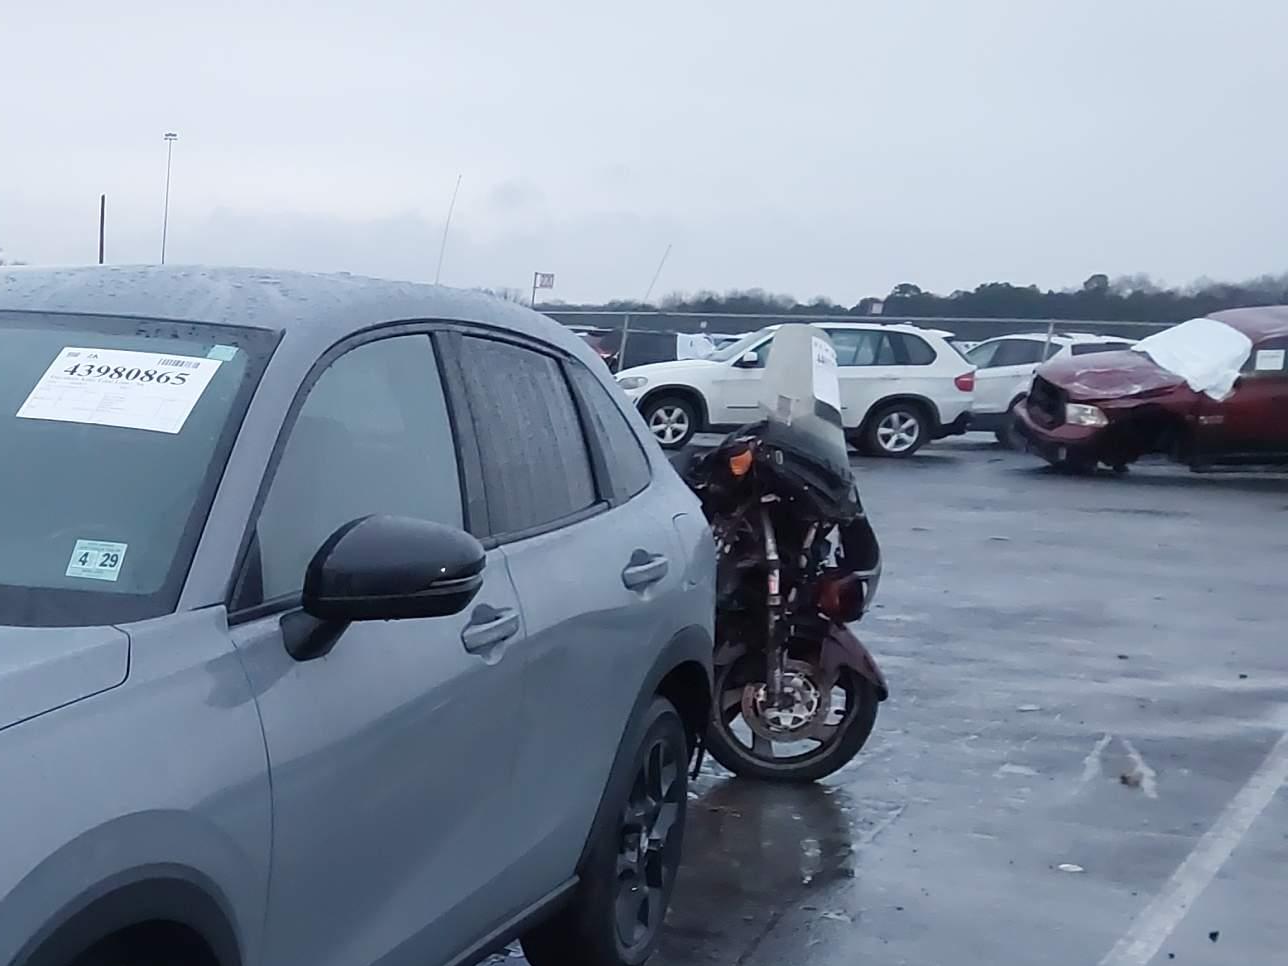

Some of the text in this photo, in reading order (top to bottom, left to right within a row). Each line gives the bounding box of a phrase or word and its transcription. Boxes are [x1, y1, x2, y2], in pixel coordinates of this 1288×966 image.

[64, 363, 190, 386] 43980865
[78, 552, 119, 568] 4 29
